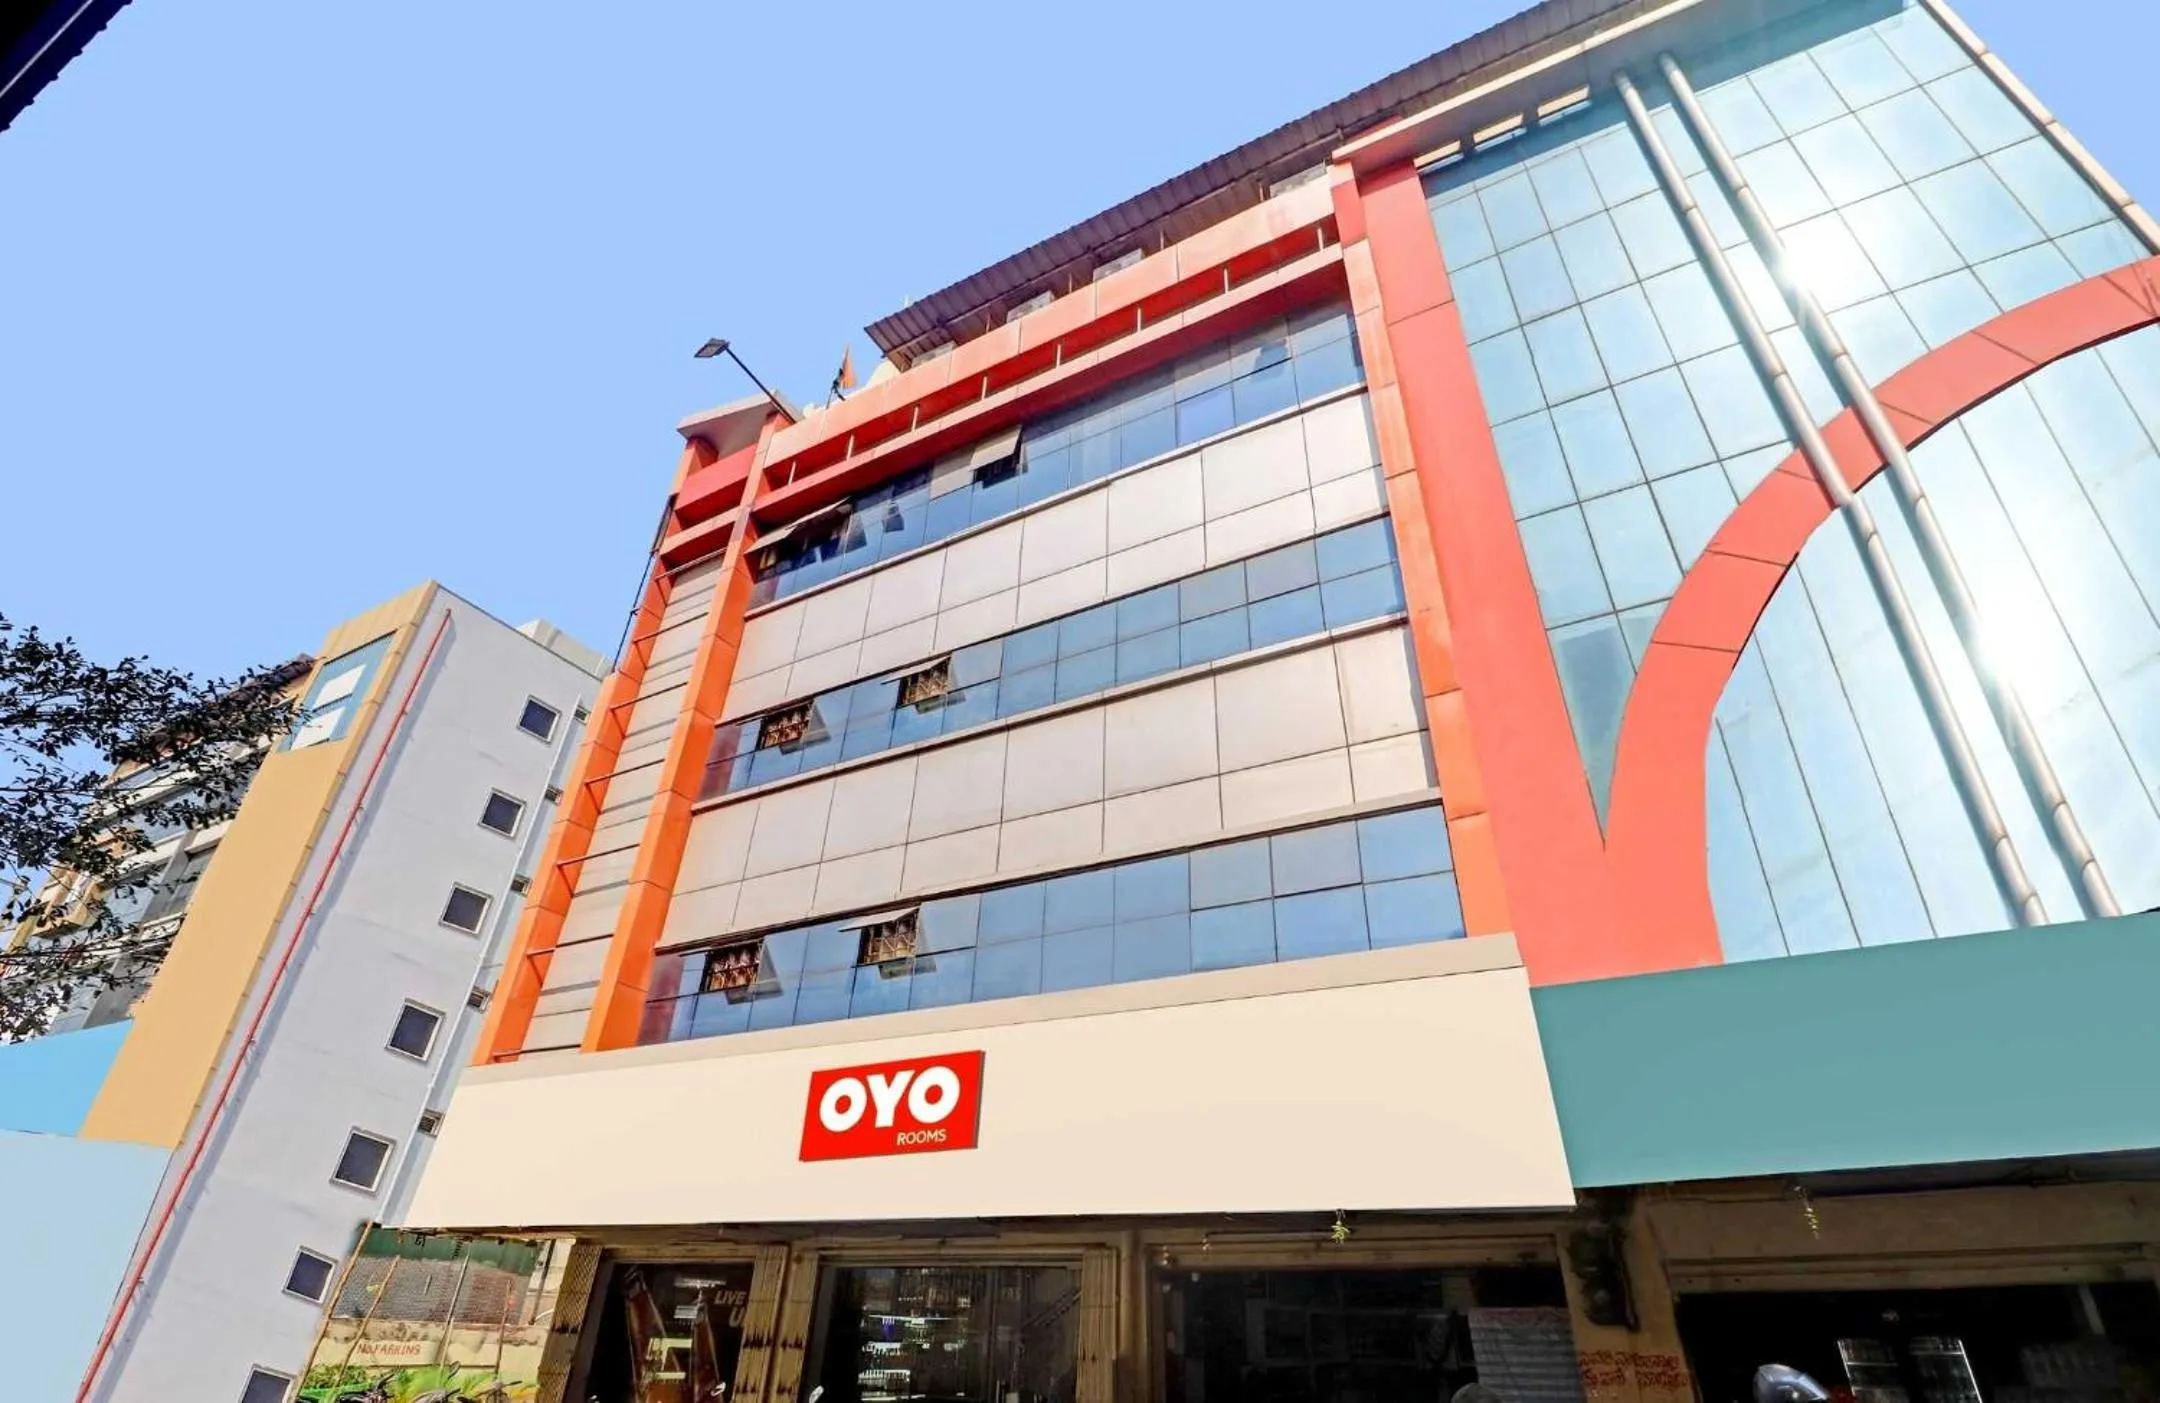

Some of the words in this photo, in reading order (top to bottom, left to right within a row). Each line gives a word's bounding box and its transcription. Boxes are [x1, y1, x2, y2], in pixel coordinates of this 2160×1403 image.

[819, 1066, 961, 1133] OYO
[896, 1128, 947, 1146] ROOMS
[714, 1290, 747, 1305] LIVE
